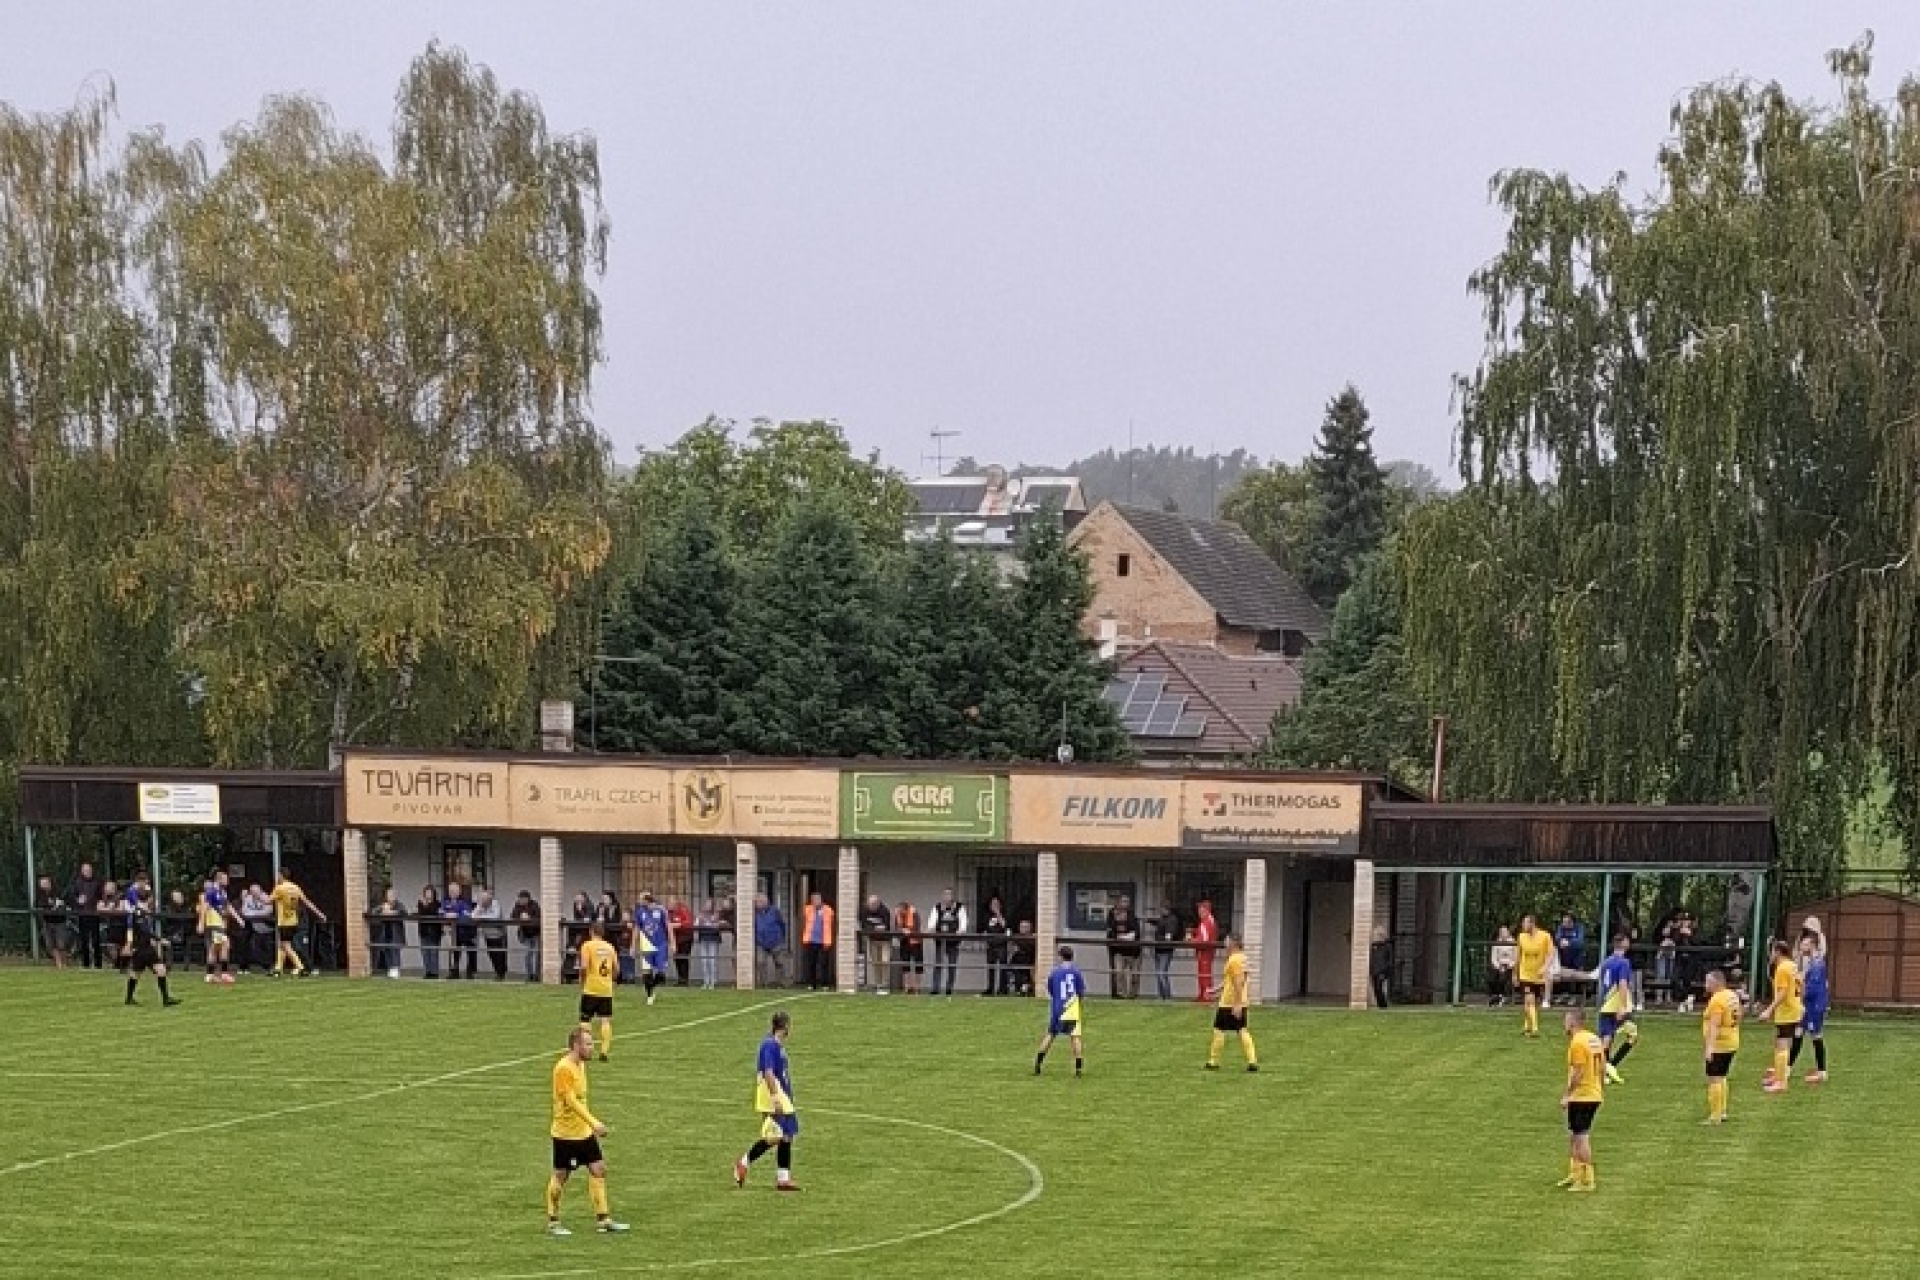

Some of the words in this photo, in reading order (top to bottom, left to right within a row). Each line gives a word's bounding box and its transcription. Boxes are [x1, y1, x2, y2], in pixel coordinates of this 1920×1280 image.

[362, 765, 493, 798] TOVÁRNA
[554, 787, 601, 802] TRAFIL
[609, 788, 661, 804] CZECH
[892, 784, 954, 812] AGRA
[1231, 792, 1342, 809] THERMOGAS
[392, 803, 462, 814] PIVOVAR
[1062, 795, 1168, 819] FILKOM
[599, 959, 610, 977] 6
